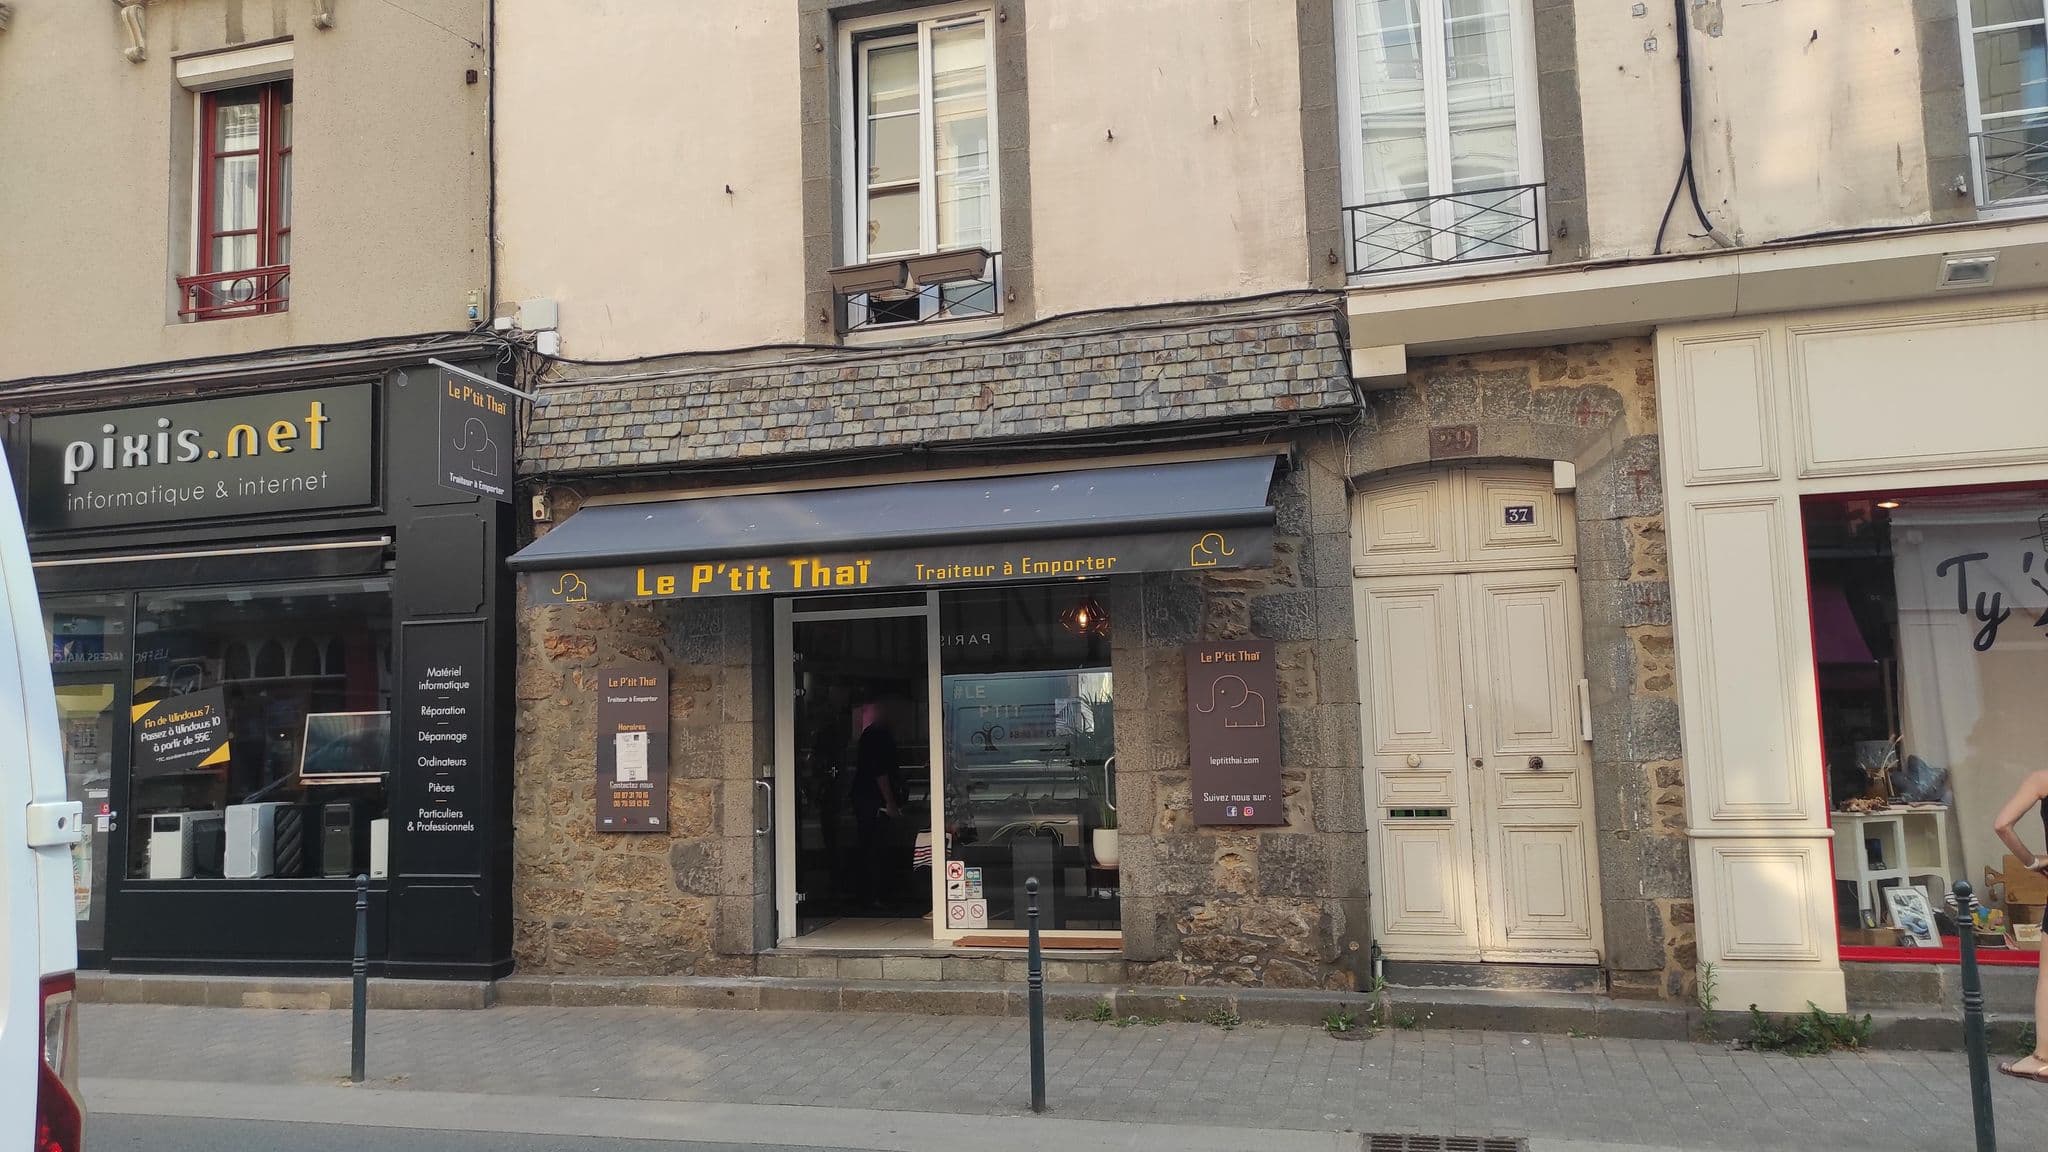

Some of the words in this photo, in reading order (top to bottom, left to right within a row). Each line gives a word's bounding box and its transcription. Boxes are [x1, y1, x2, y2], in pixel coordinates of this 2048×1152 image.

[448, 379, 460, 400] Le
[487, 393, 507, 415] Thaï
[64, 401, 330, 485] pixis.net
[68, 483, 205, 512] informatique
[215, 480, 229, 499] &
[239, 470, 328, 496] internet
[1508, 508, 1529, 522] 37
[915, 564, 995, 581] Traiteur
[1004, 562, 1012, 576] à
[1022, 556, 1117, 575] Emporter
[637, 567, 675, 596] Le
[692, 563, 772, 593] P'tit
[791, 560, 872, 588] Thaï
[1201, 652, 1212, 663] Le
[1239, 650, 1260, 661] Thaï
[427, 666, 461, 677] Matériel
[419, 680, 469, 691] informatique
[609, 678, 618, 687] Le
[639, 676, 656, 687] Thaï
[157, 715, 167, 725] de
[168, 710, 203, 723] Windows
[204, 705, 210, 715] 7
[421, 706, 466, 718] Réparation
[140, 730, 167, 742] Passez
[169, 727, 174, 736] à
[176, 720, 211, 734] Windows
[212, 717, 221, 727] 10
[418, 731, 468, 743] Dépannage
[153, 743, 160, 752] à
[161, 739, 182, 753] partir
[184, 736, 193, 746] de
[417, 756, 467, 767] Ordinateurs
[1210, 756, 1260, 765] leptitthai.com
[428, 783, 455, 793] Pièces
[1203, 792, 1229, 802] Suivez
[418, 808, 463, 818] Particuliers
[407, 822, 414, 831] &
[416, 821, 475, 832] Professionnels
